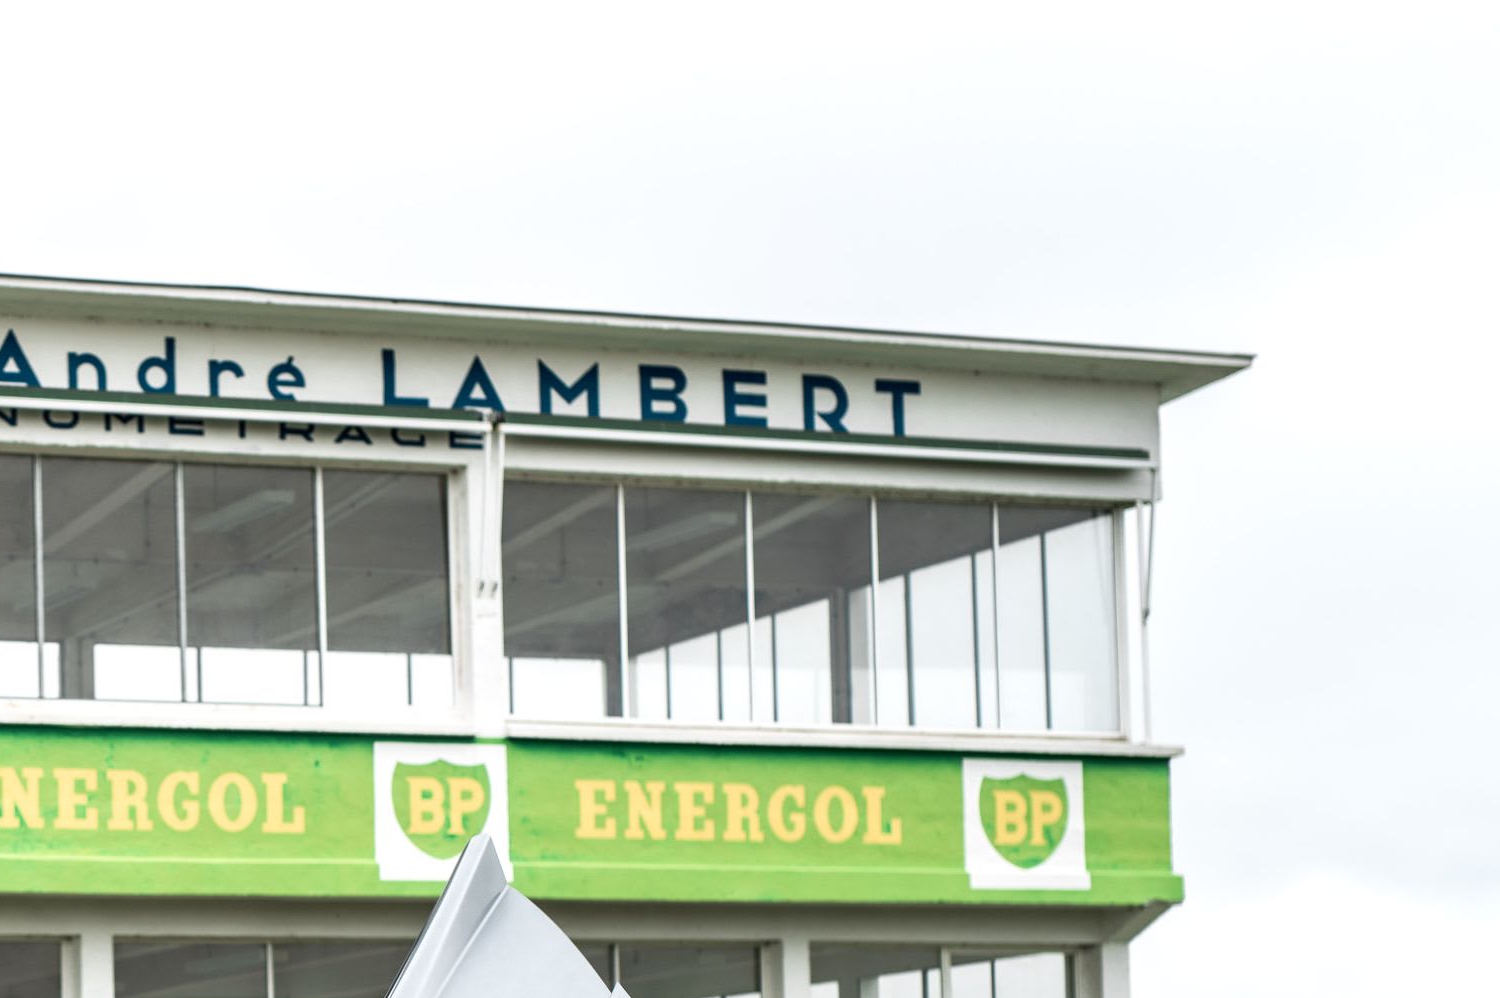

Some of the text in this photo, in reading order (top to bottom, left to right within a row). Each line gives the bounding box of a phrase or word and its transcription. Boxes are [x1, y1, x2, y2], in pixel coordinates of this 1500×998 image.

[382, 349, 921, 436] LAMBERT
[406, 776, 485, 836] BP
[574, 779, 901, 846] ENERGOL
[993, 789, 1063, 846] BP
